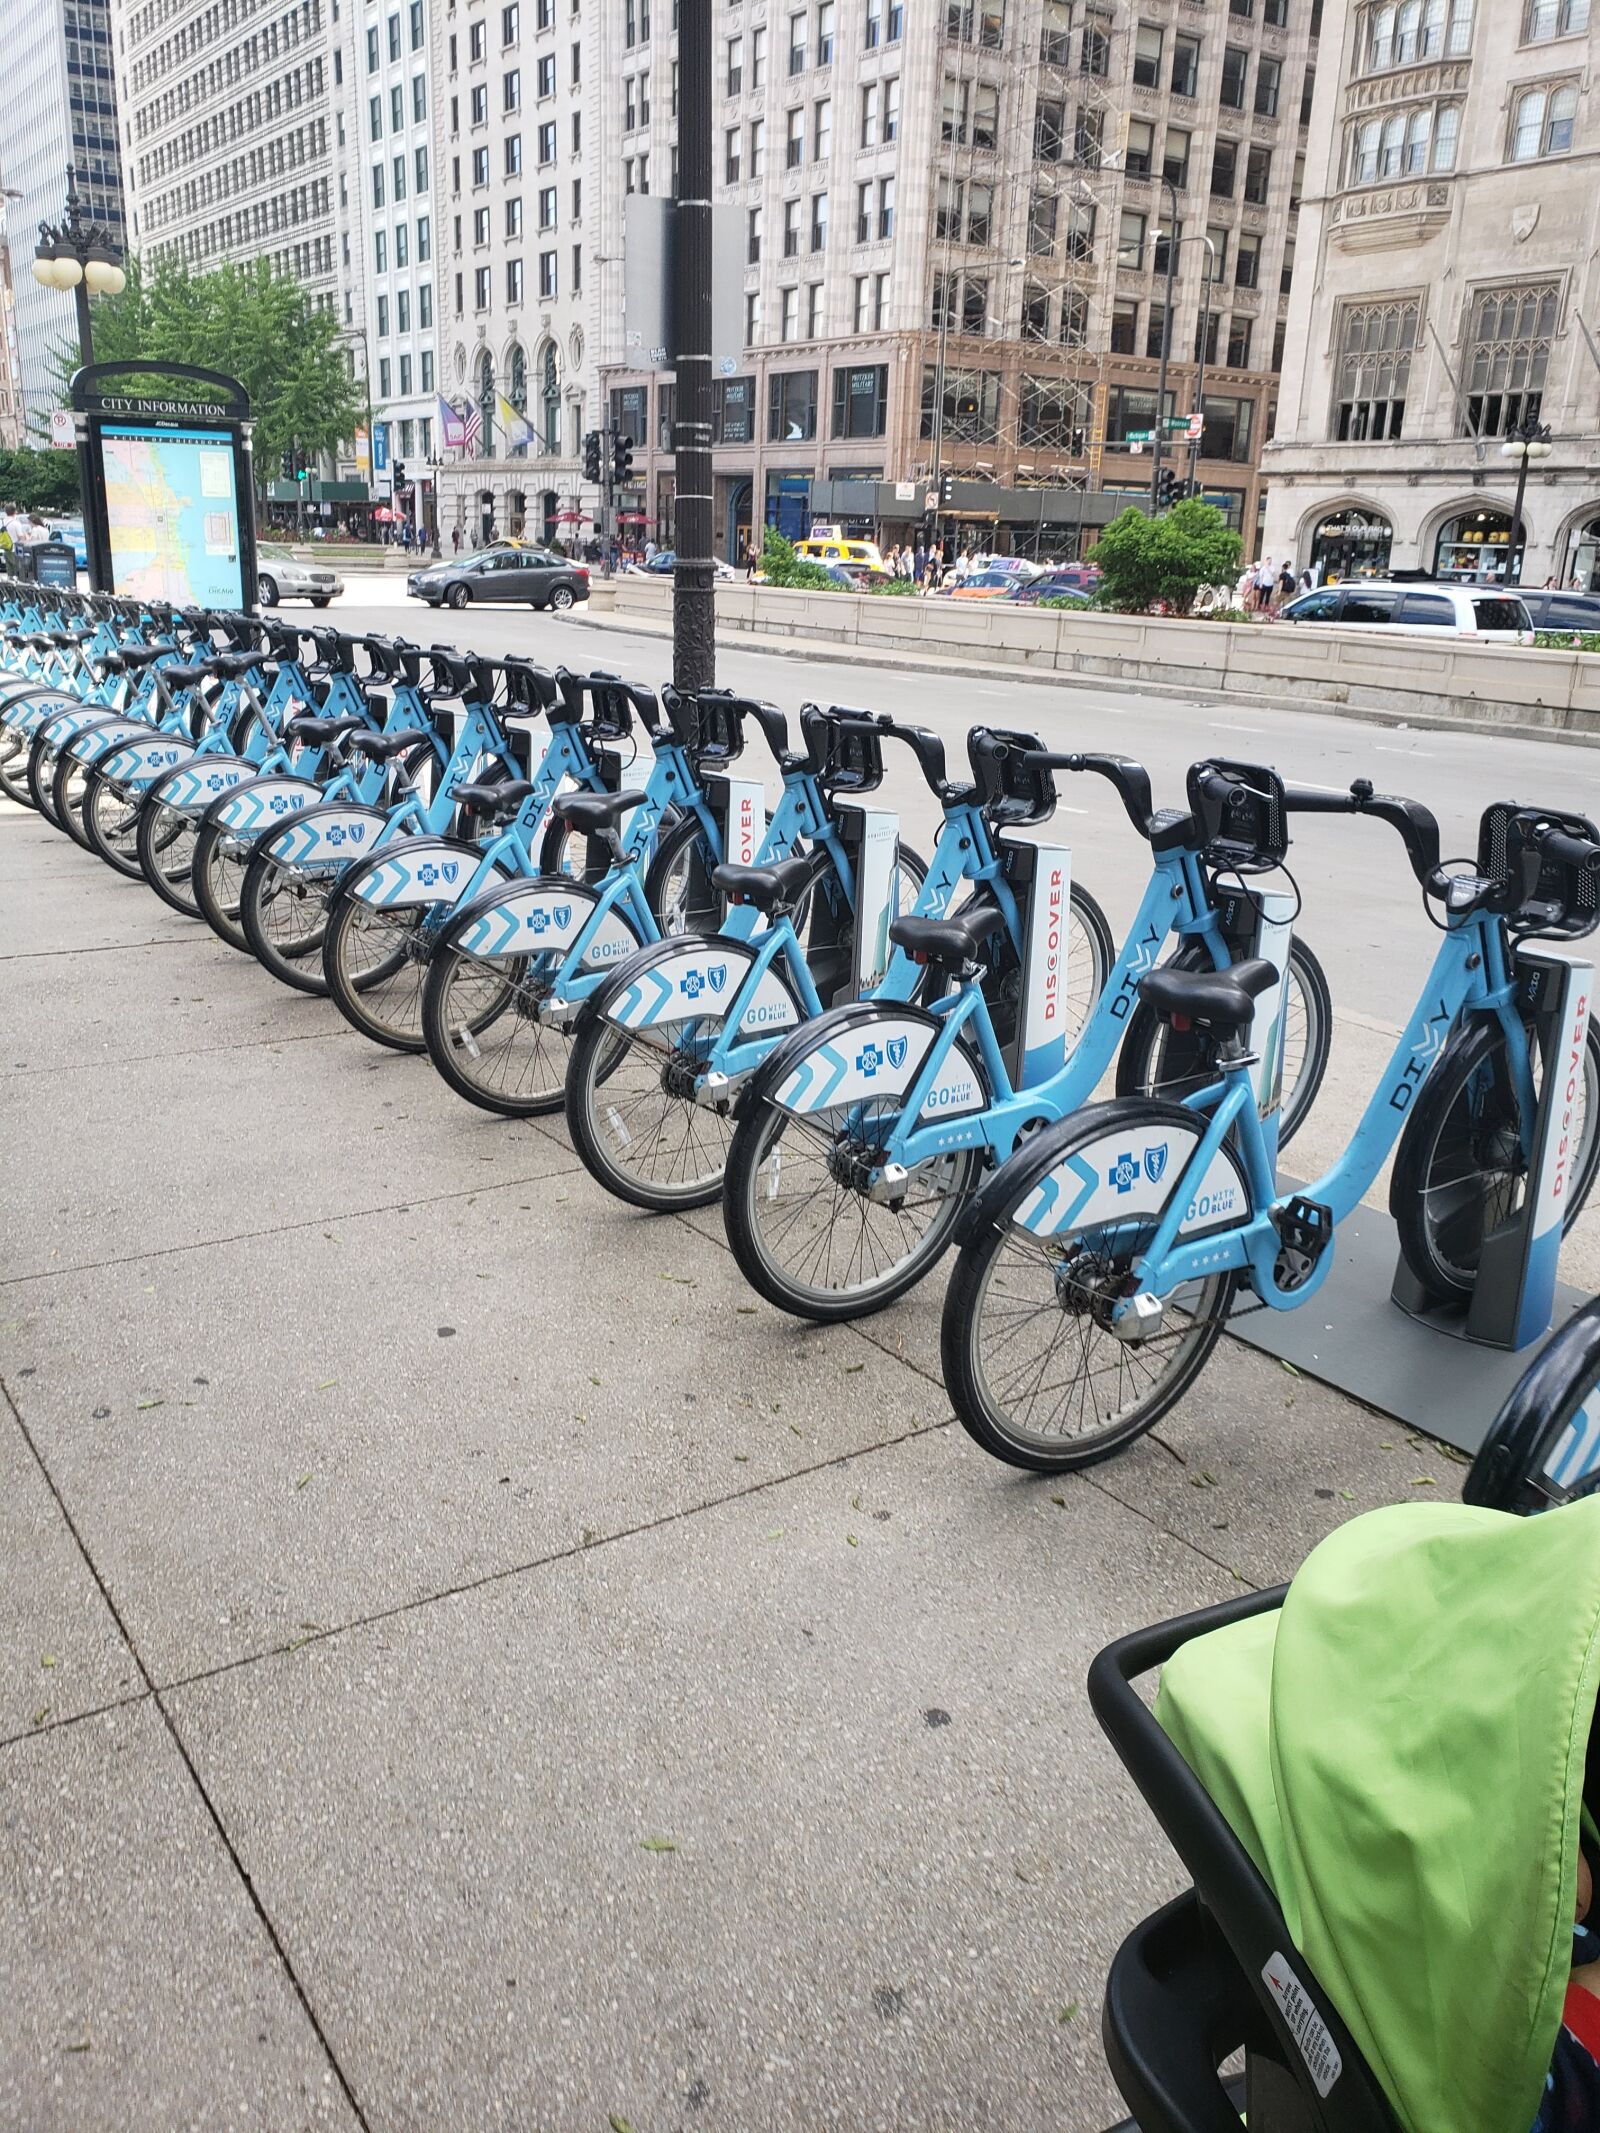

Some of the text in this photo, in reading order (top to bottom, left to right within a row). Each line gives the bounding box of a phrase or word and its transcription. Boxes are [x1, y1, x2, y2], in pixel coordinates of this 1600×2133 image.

[101, 398, 226, 416] CITY INFORMATION
[741, 798, 752, 863] OVER
[591, 939, 630, 959] GO WITH
[612, 947, 630, 956] BLUE
[1044, 868, 1062, 1021] DISCOVER
[747, 1001, 787, 1025] GO WITH
[768, 1010, 786, 1021] BLUE
[927, 1082, 972, 1108] GO WITH
[951, 1091, 971, 1104] BLUE
[1552, 994, 1587, 1198] DISCOVER
[1185, 1187, 1235, 1221] GO WITH
[1211, 1198, 1234, 1214] BLUE
[1282, 1981, 1293, 2001] Arrow
[1290, 1984, 1300, 2004] point
[1294, 1998, 1303, 2015] when
